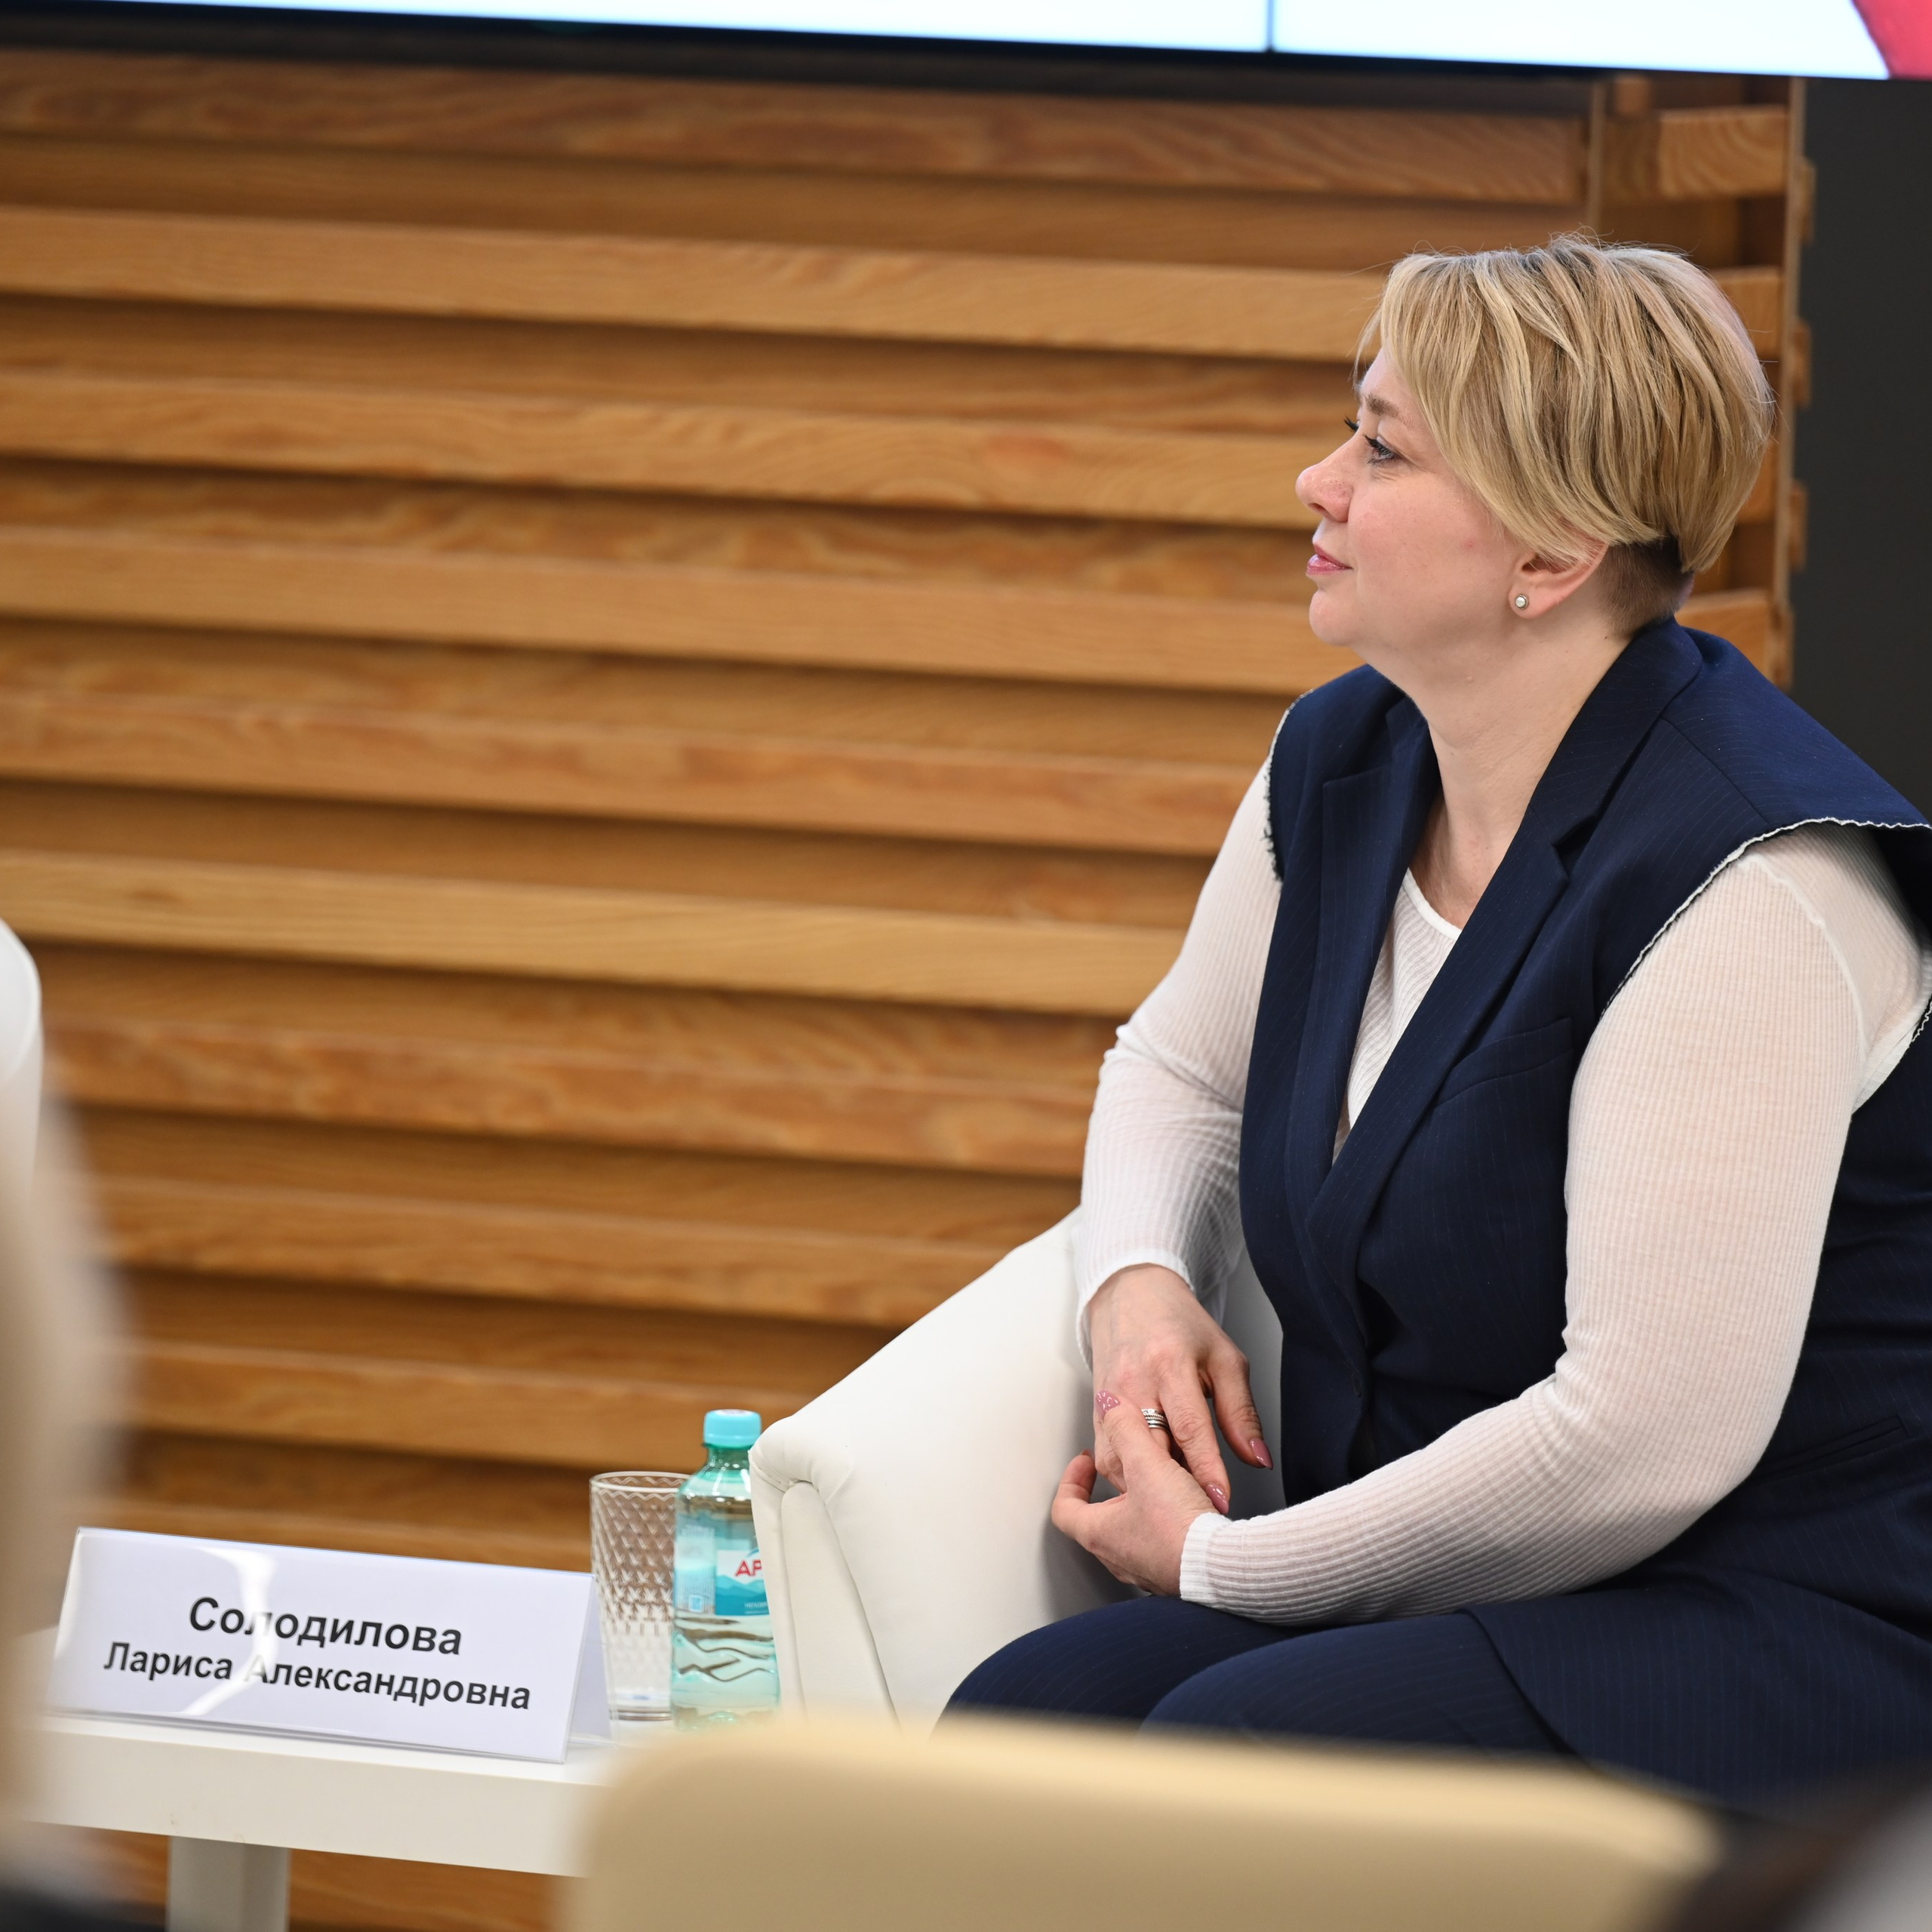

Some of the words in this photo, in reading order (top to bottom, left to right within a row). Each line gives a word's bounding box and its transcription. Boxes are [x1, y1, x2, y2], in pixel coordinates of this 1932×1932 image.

[189, 1596, 462, 1655] Солодилова
[103, 1641, 233, 1681] Лариса
[243, 1654, 531, 1710] Александровна
